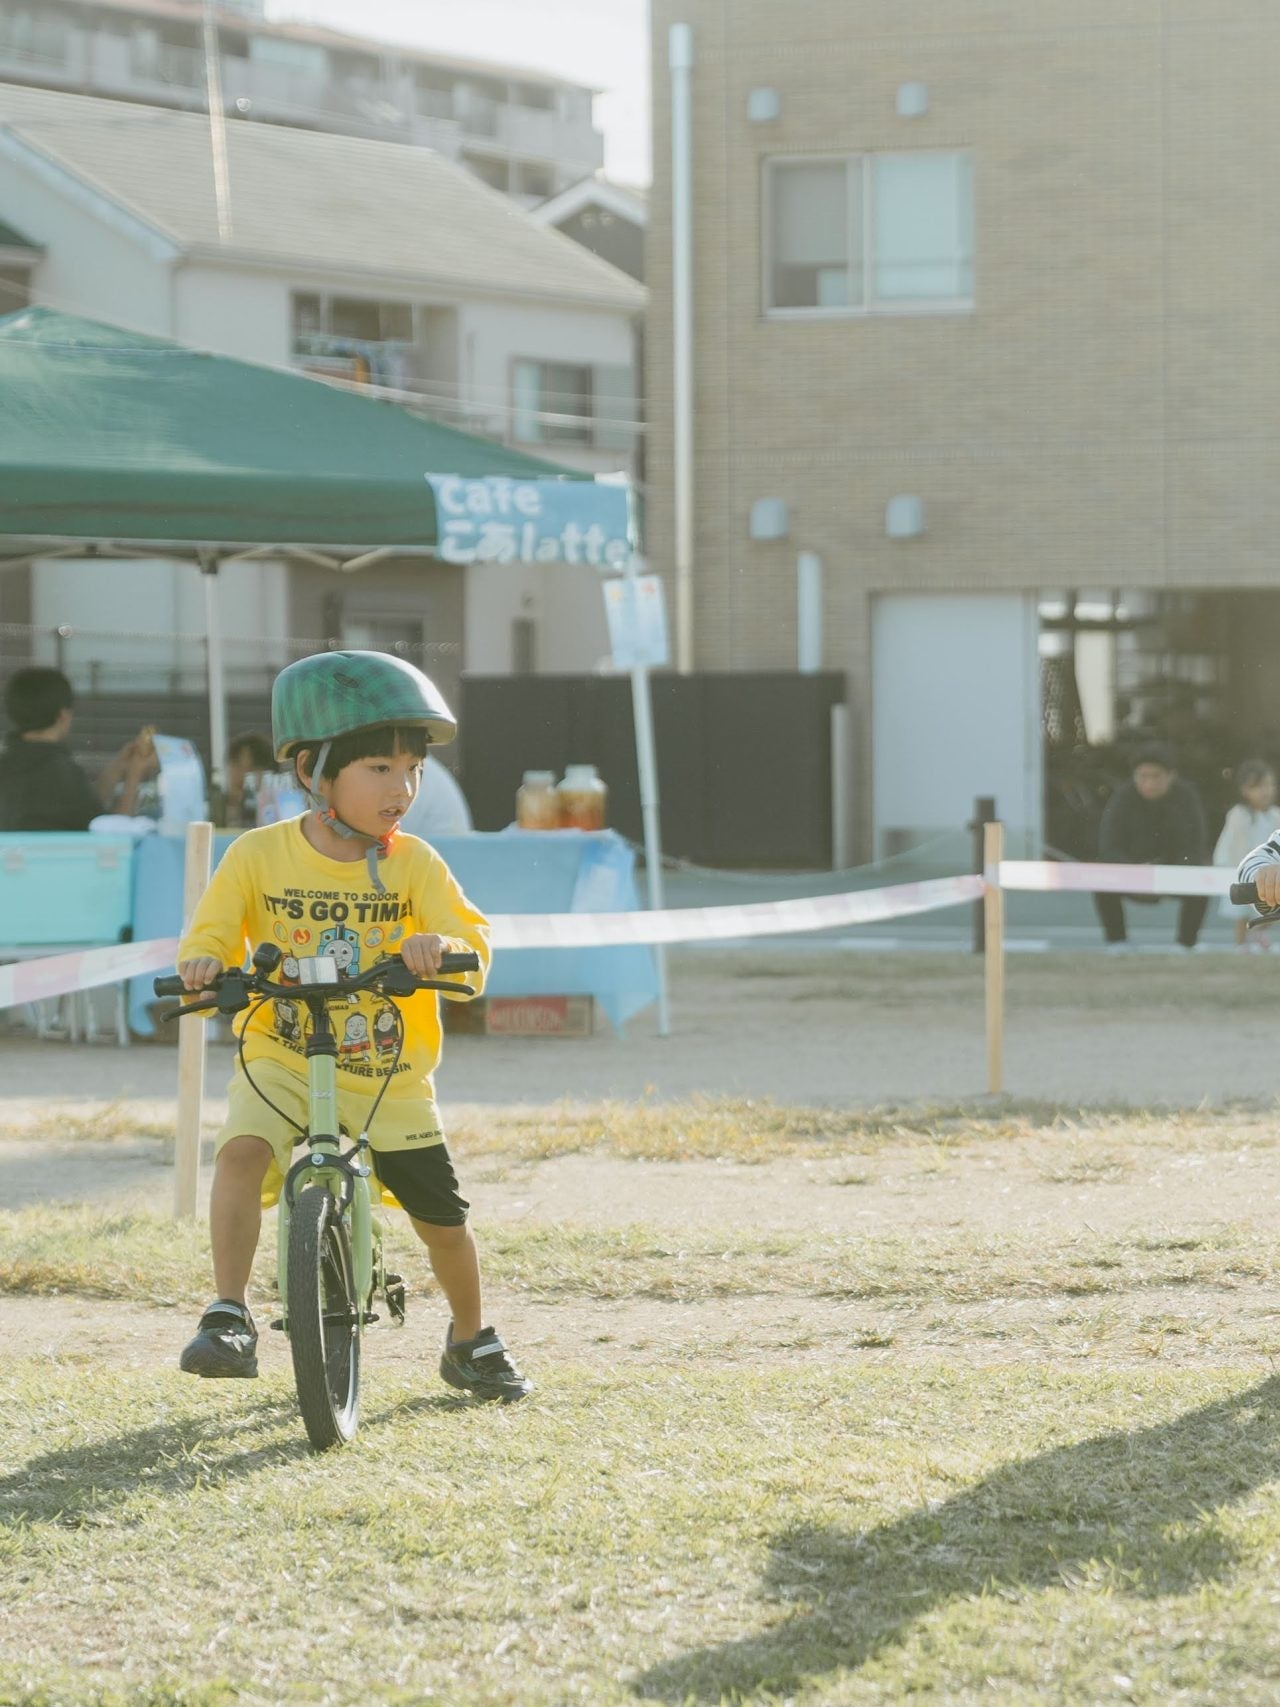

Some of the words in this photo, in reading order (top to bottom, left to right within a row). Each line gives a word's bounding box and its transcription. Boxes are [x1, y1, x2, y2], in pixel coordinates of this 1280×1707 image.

[283, 887, 340, 901] WELCOME
[343, 892, 359, 901] TO
[362, 892, 399, 902] SODOR
[261, 892, 305, 920] IT'S
[309, 900, 350, 922] GO
